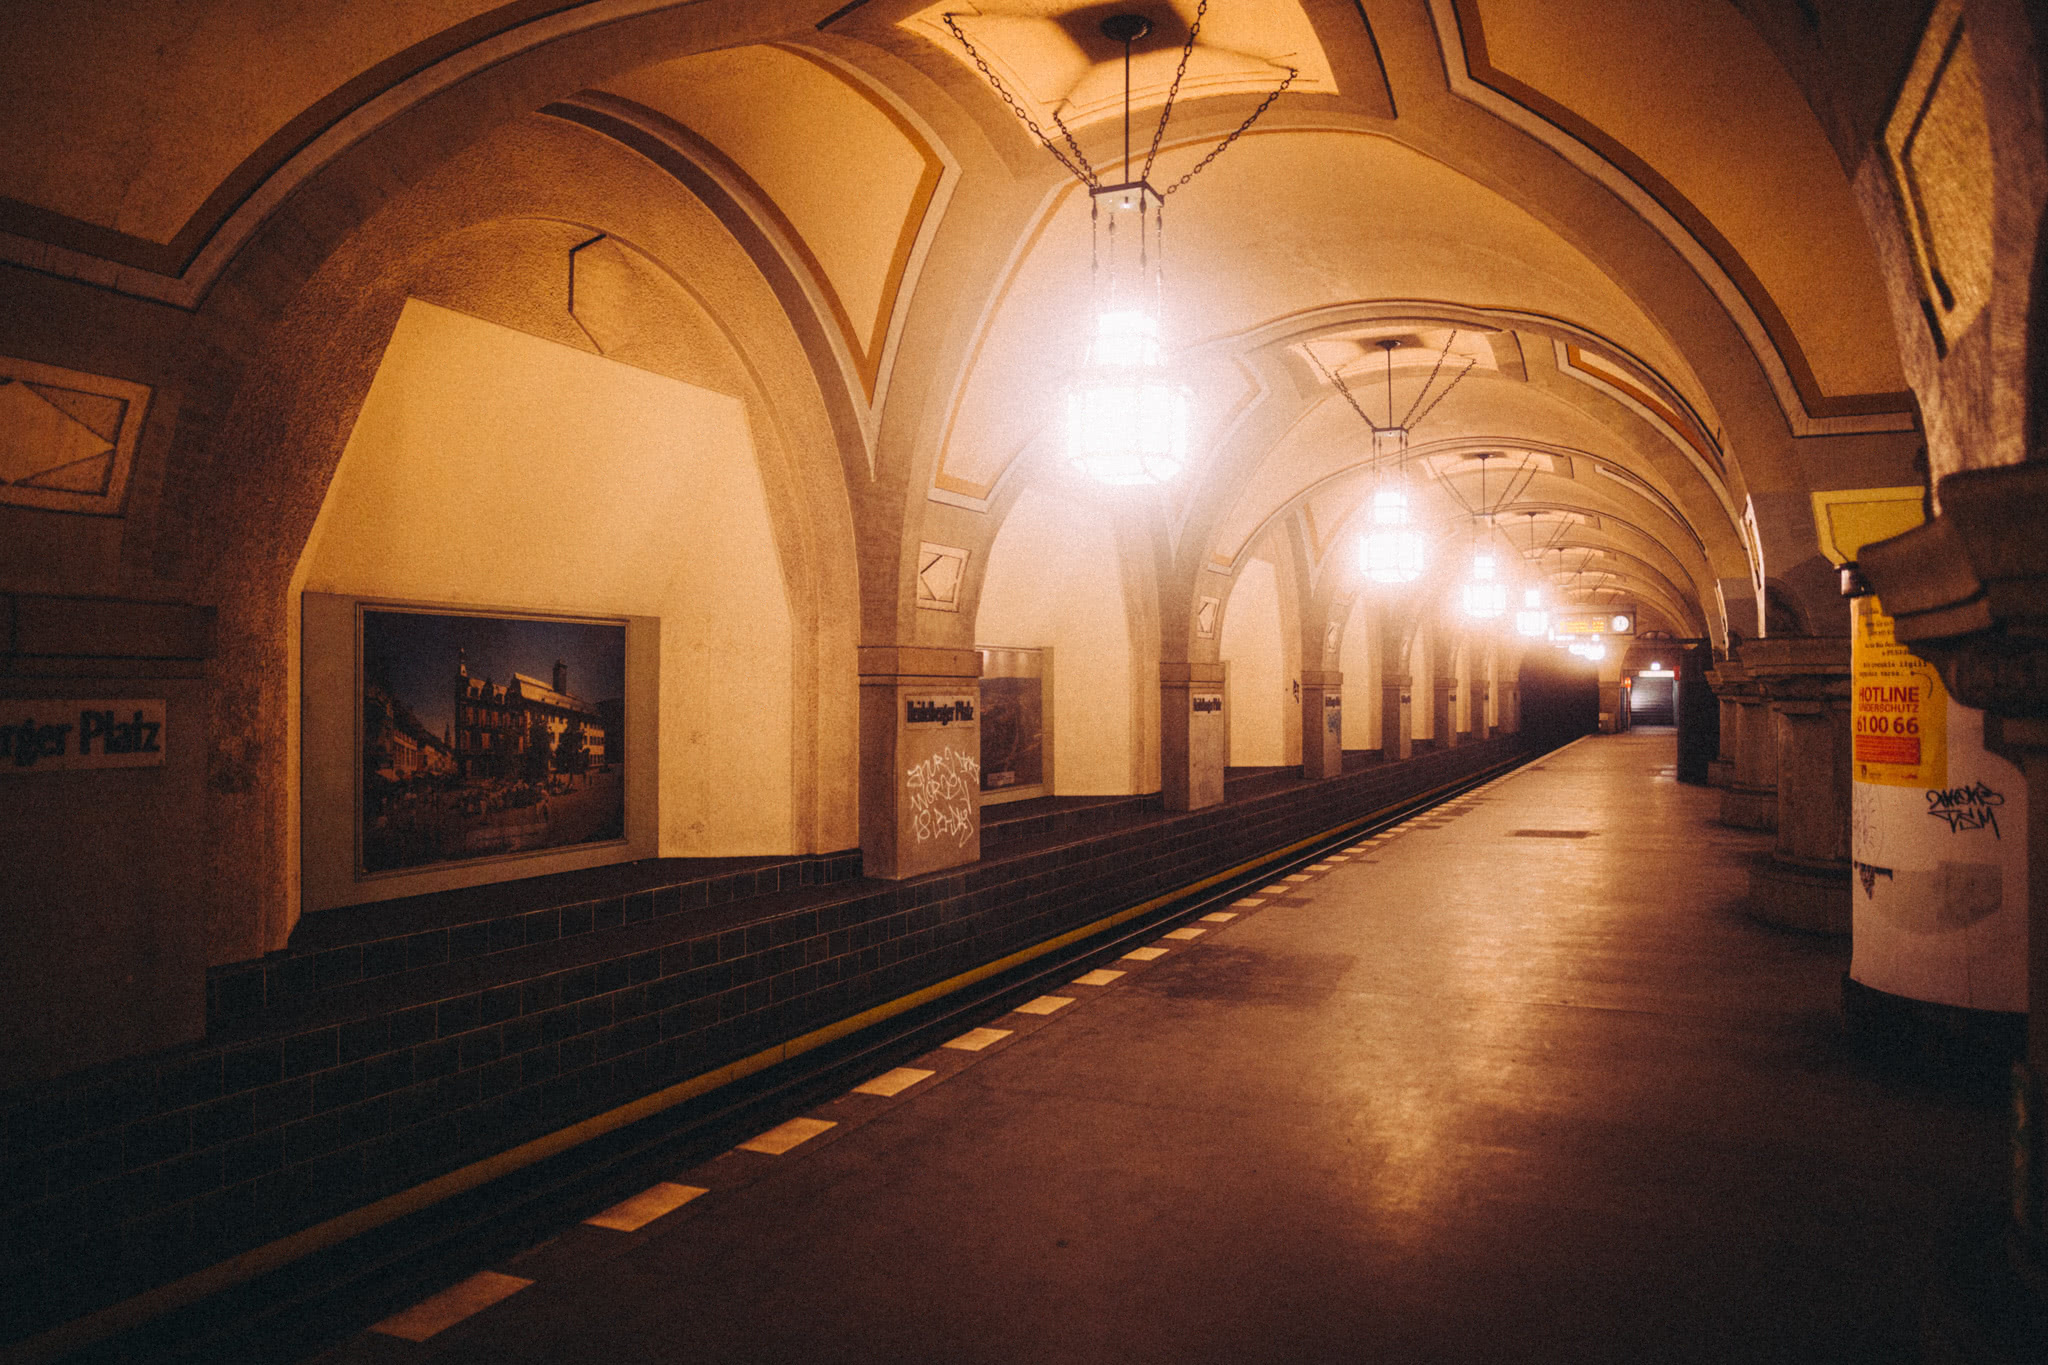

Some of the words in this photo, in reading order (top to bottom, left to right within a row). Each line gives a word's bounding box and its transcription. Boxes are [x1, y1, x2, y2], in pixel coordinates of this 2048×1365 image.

[1859, 686, 1920, 703] HOTLINE
[80, 710, 161, 755] Platz
[1857, 715, 1867, 732] 61
[1869, 715, 1889, 733] 00
[1893, 716, 1919, 735] 66
